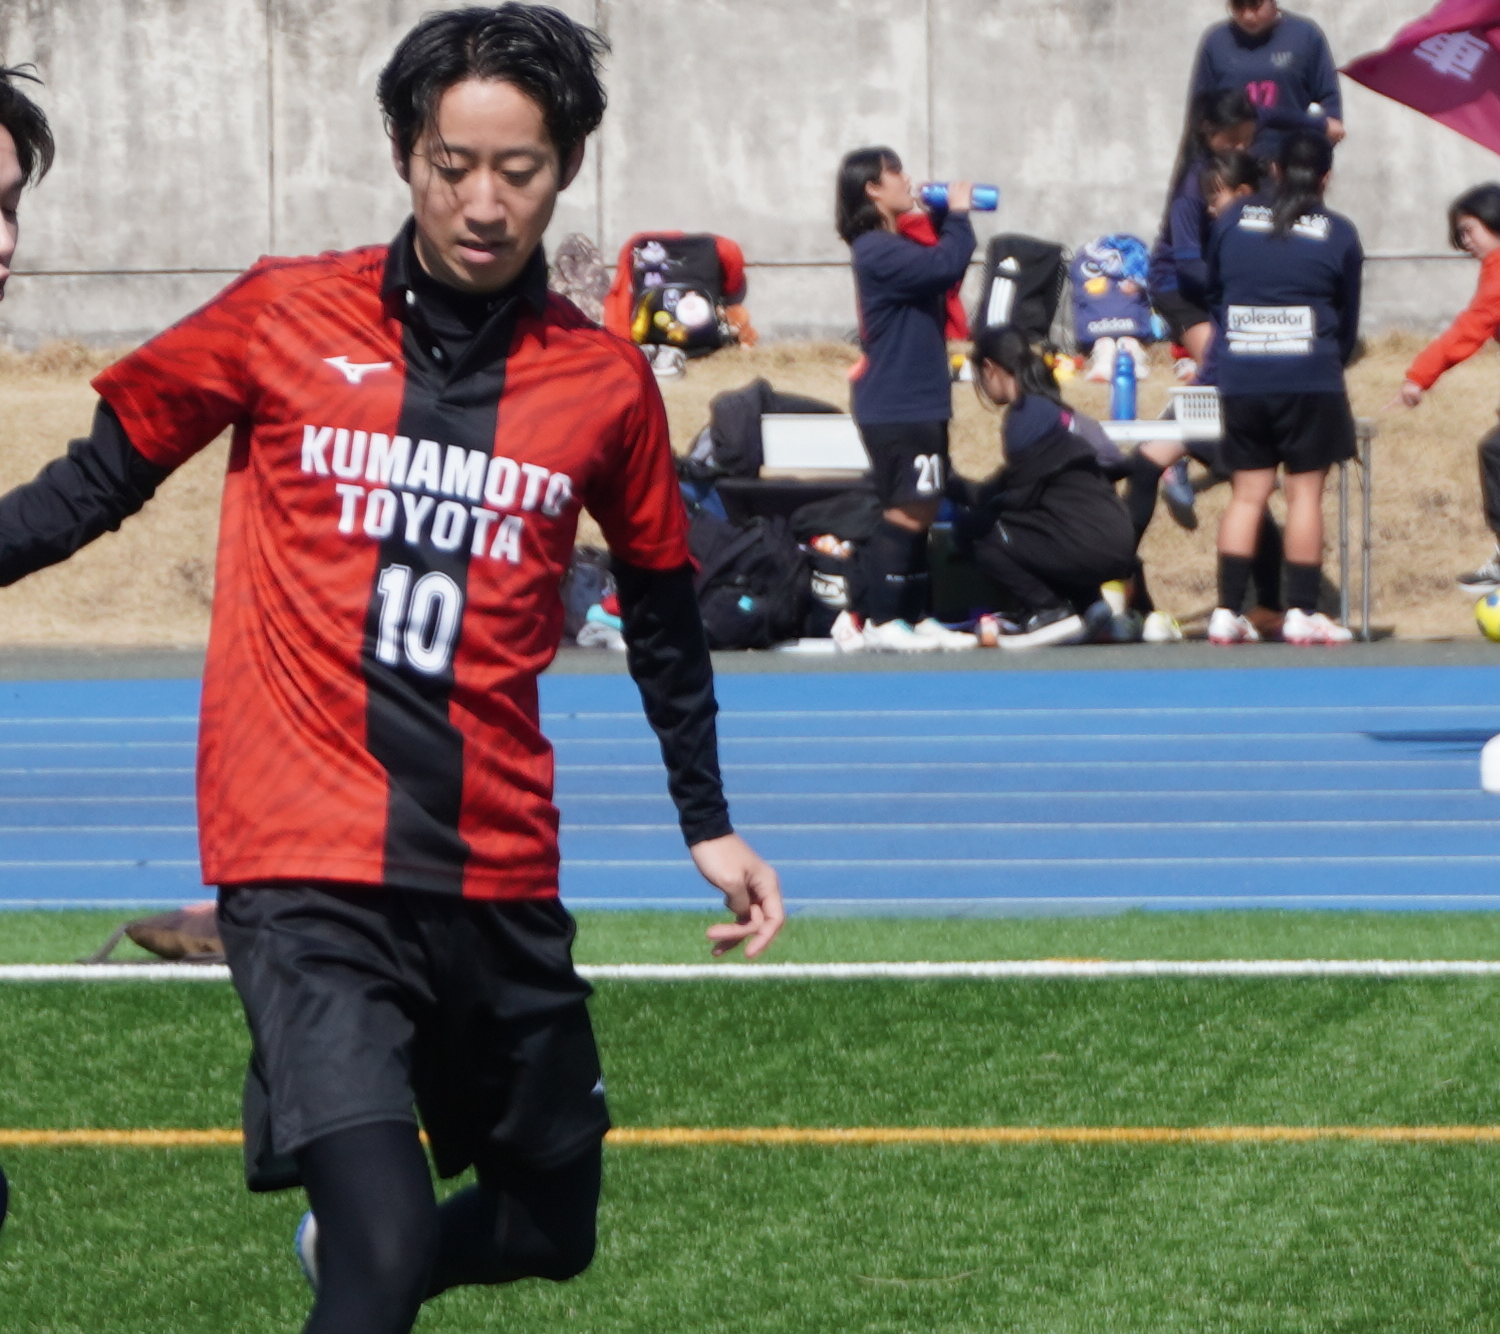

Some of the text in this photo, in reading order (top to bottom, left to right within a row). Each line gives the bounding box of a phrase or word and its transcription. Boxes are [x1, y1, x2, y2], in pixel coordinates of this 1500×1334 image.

[1232, 308, 1305, 328] goleador
[300, 425, 573, 517] KUMAMOTO
[913, 453, 941, 494] 21
[335, 483, 524, 563] TOYOTA
[375, 563, 463, 674] 10
